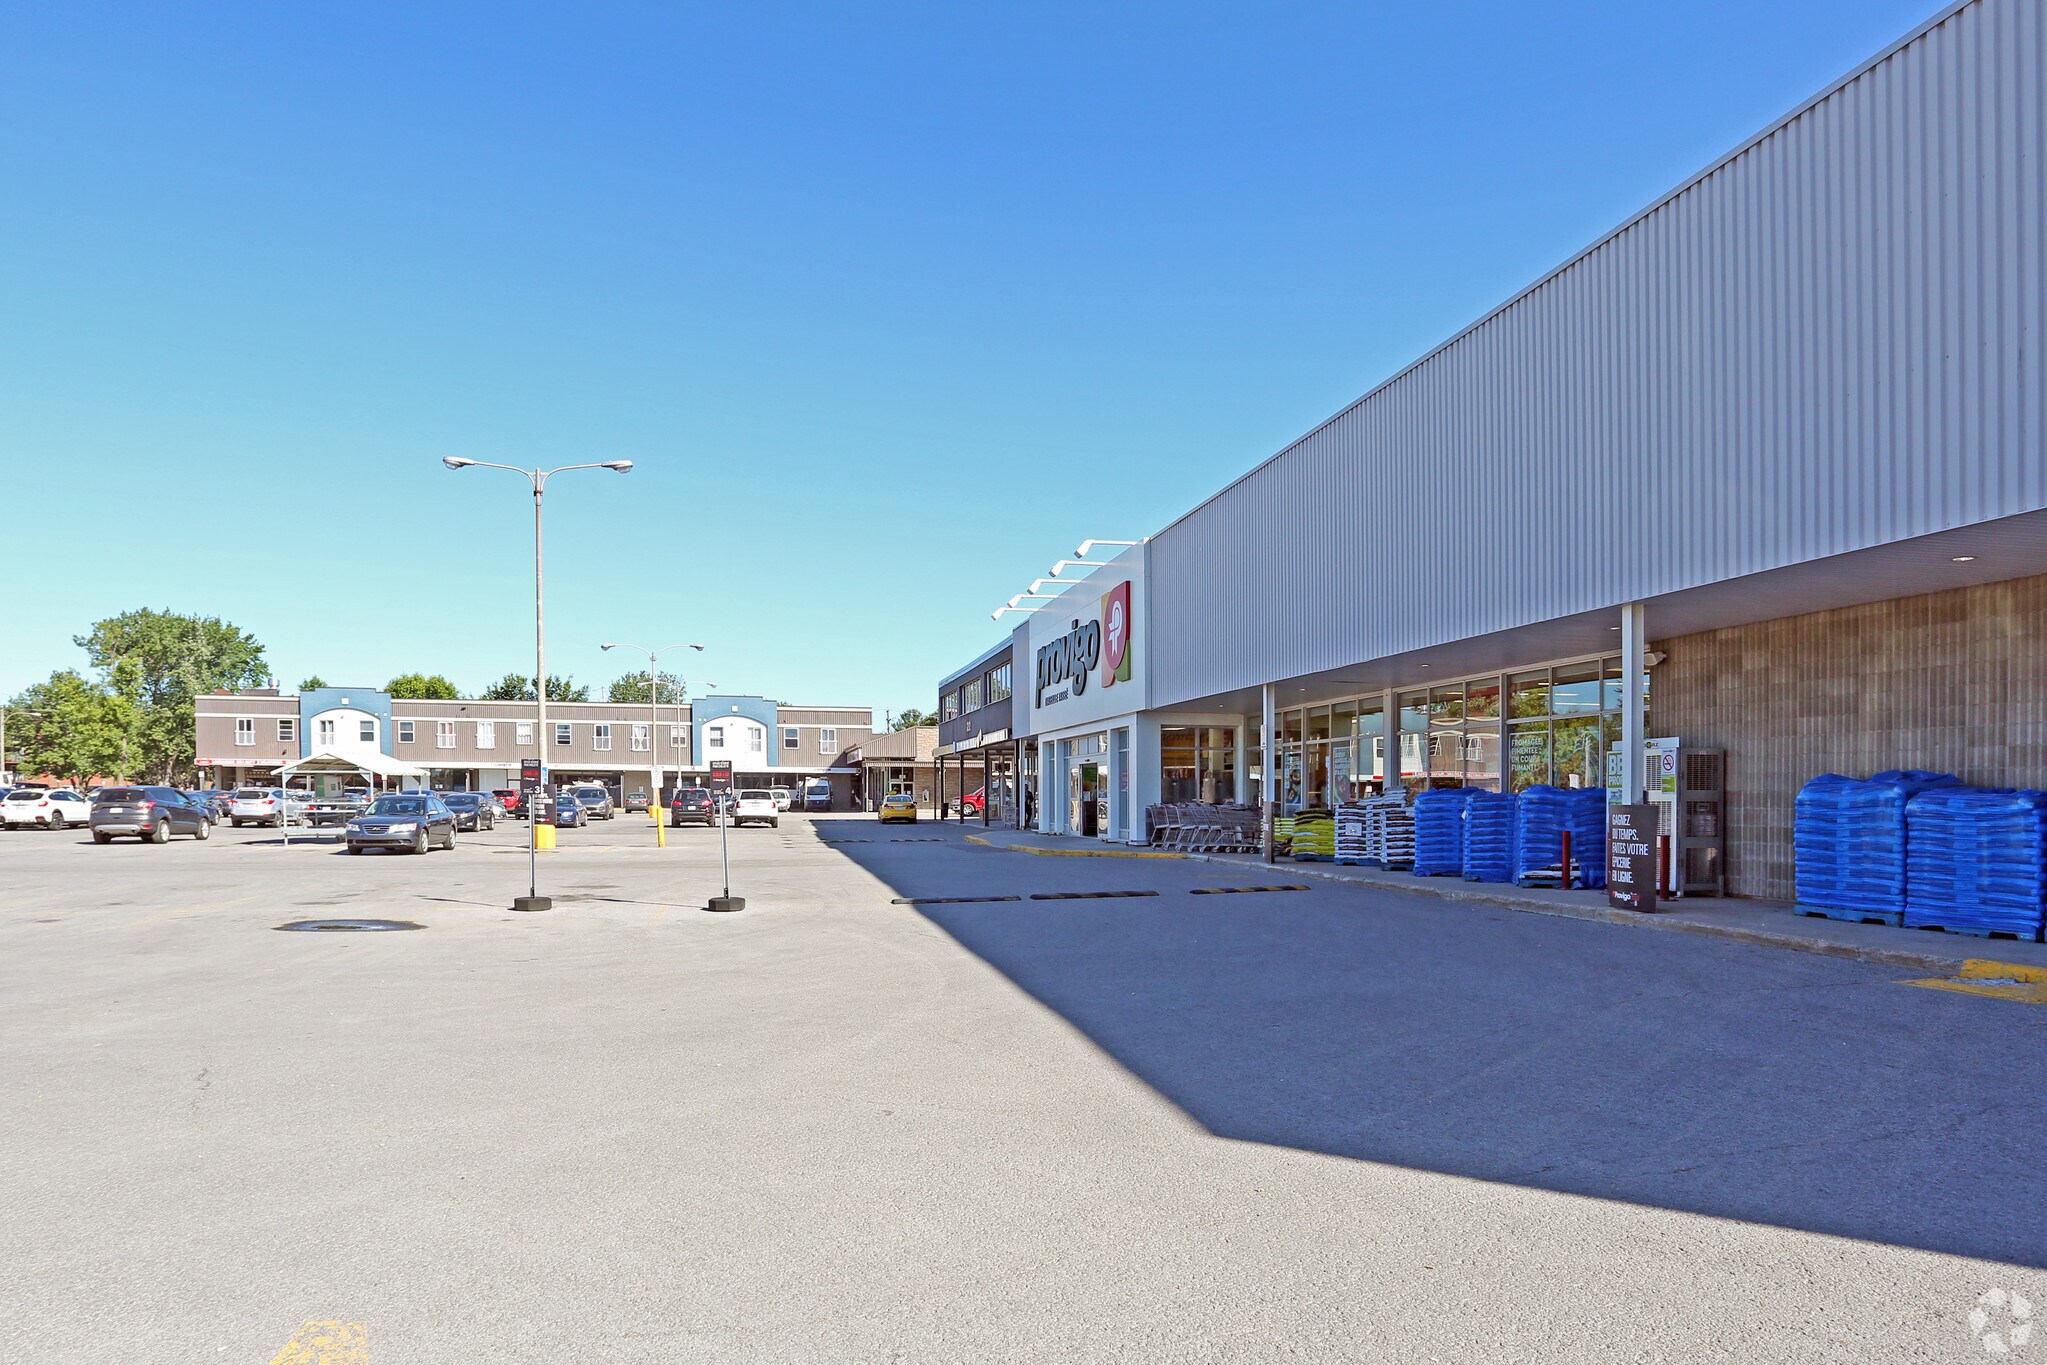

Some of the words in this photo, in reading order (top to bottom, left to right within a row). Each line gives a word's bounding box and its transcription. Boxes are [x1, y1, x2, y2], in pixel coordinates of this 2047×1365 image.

[1035, 619, 1101, 709] provigo
[534, 785, 541, 794] 3
[725, 786, 732, 795] 4
[1618, 829, 1639, 841] TEMPS.
[1626, 843, 1649, 856] VOTRE
